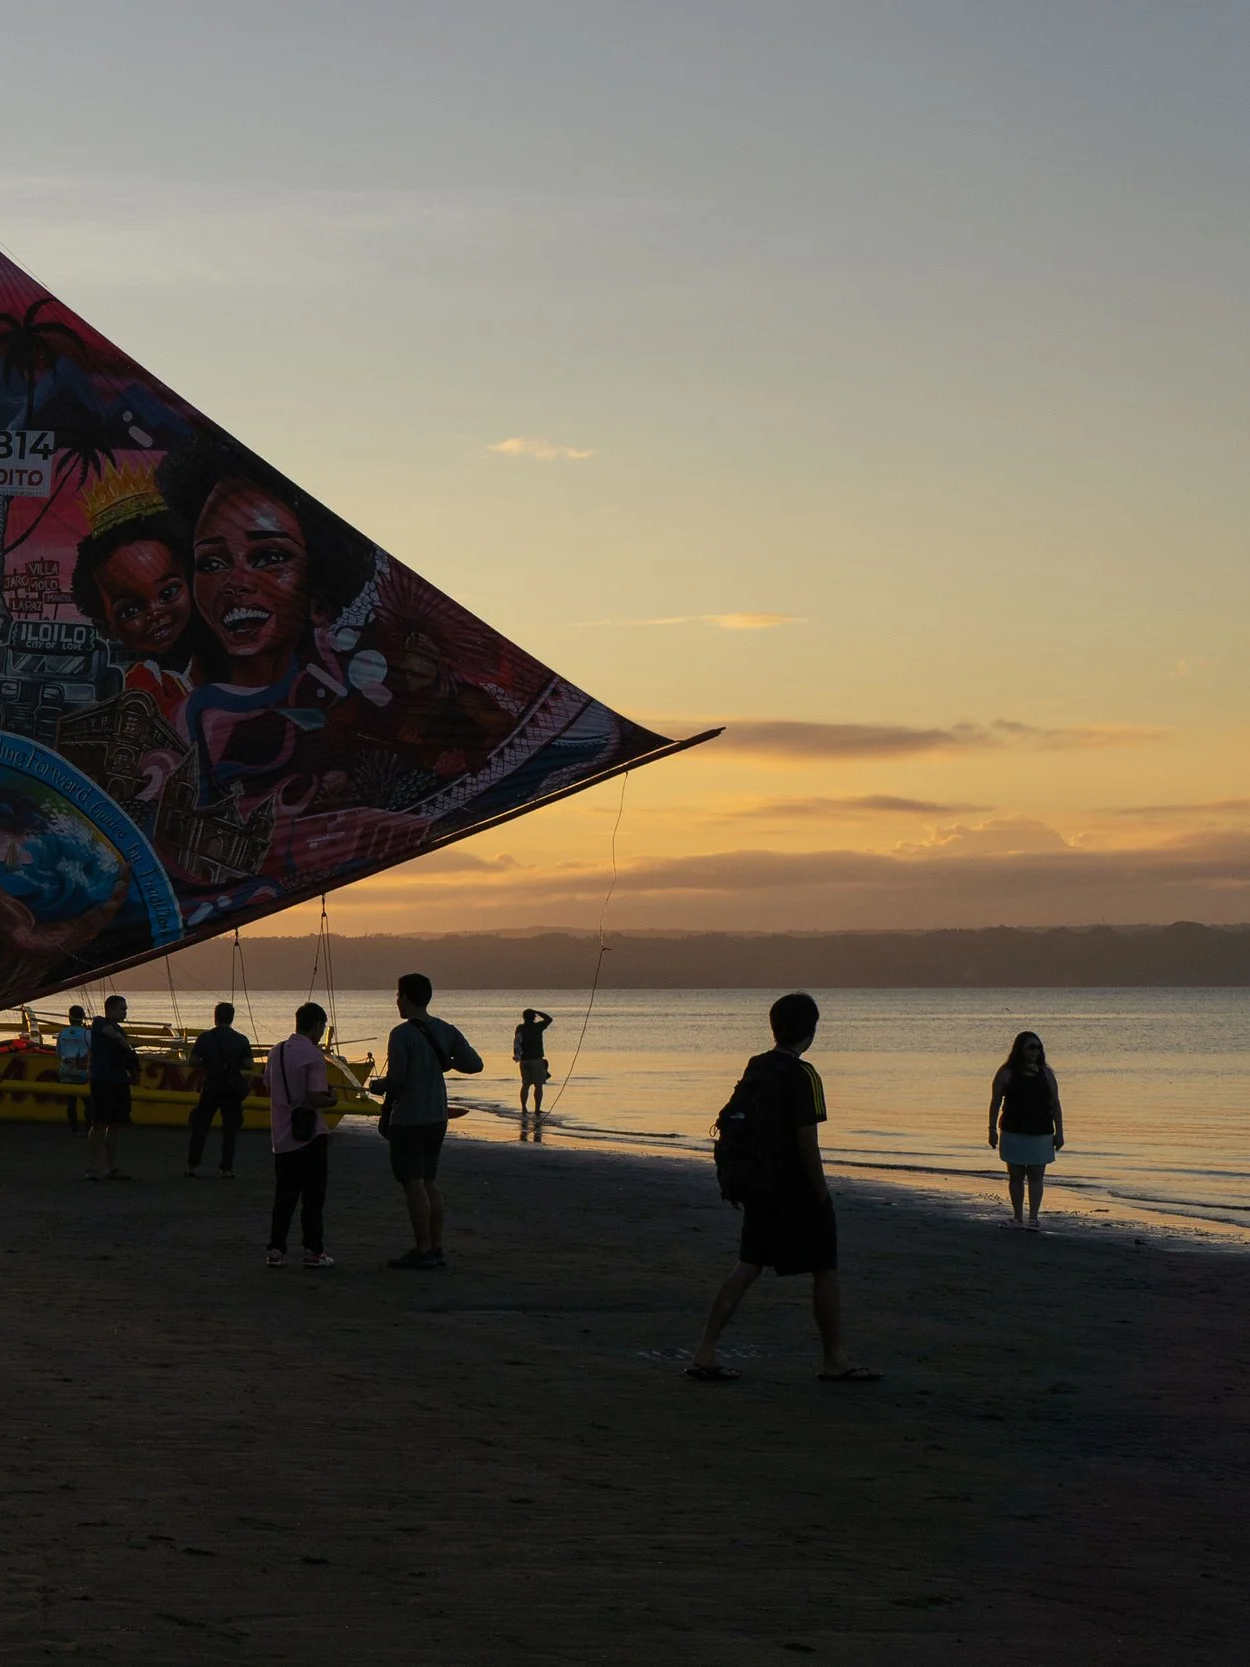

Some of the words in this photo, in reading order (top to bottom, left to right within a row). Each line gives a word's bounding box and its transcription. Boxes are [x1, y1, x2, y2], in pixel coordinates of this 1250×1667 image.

[29, 562, 58, 576] VILLA
[3, 576, 29, 589] JARO
[20, 623, 87, 644] ILOILO
[26, 641, 44, 649] CITY
[62, 643, 83, 651] LOVE
